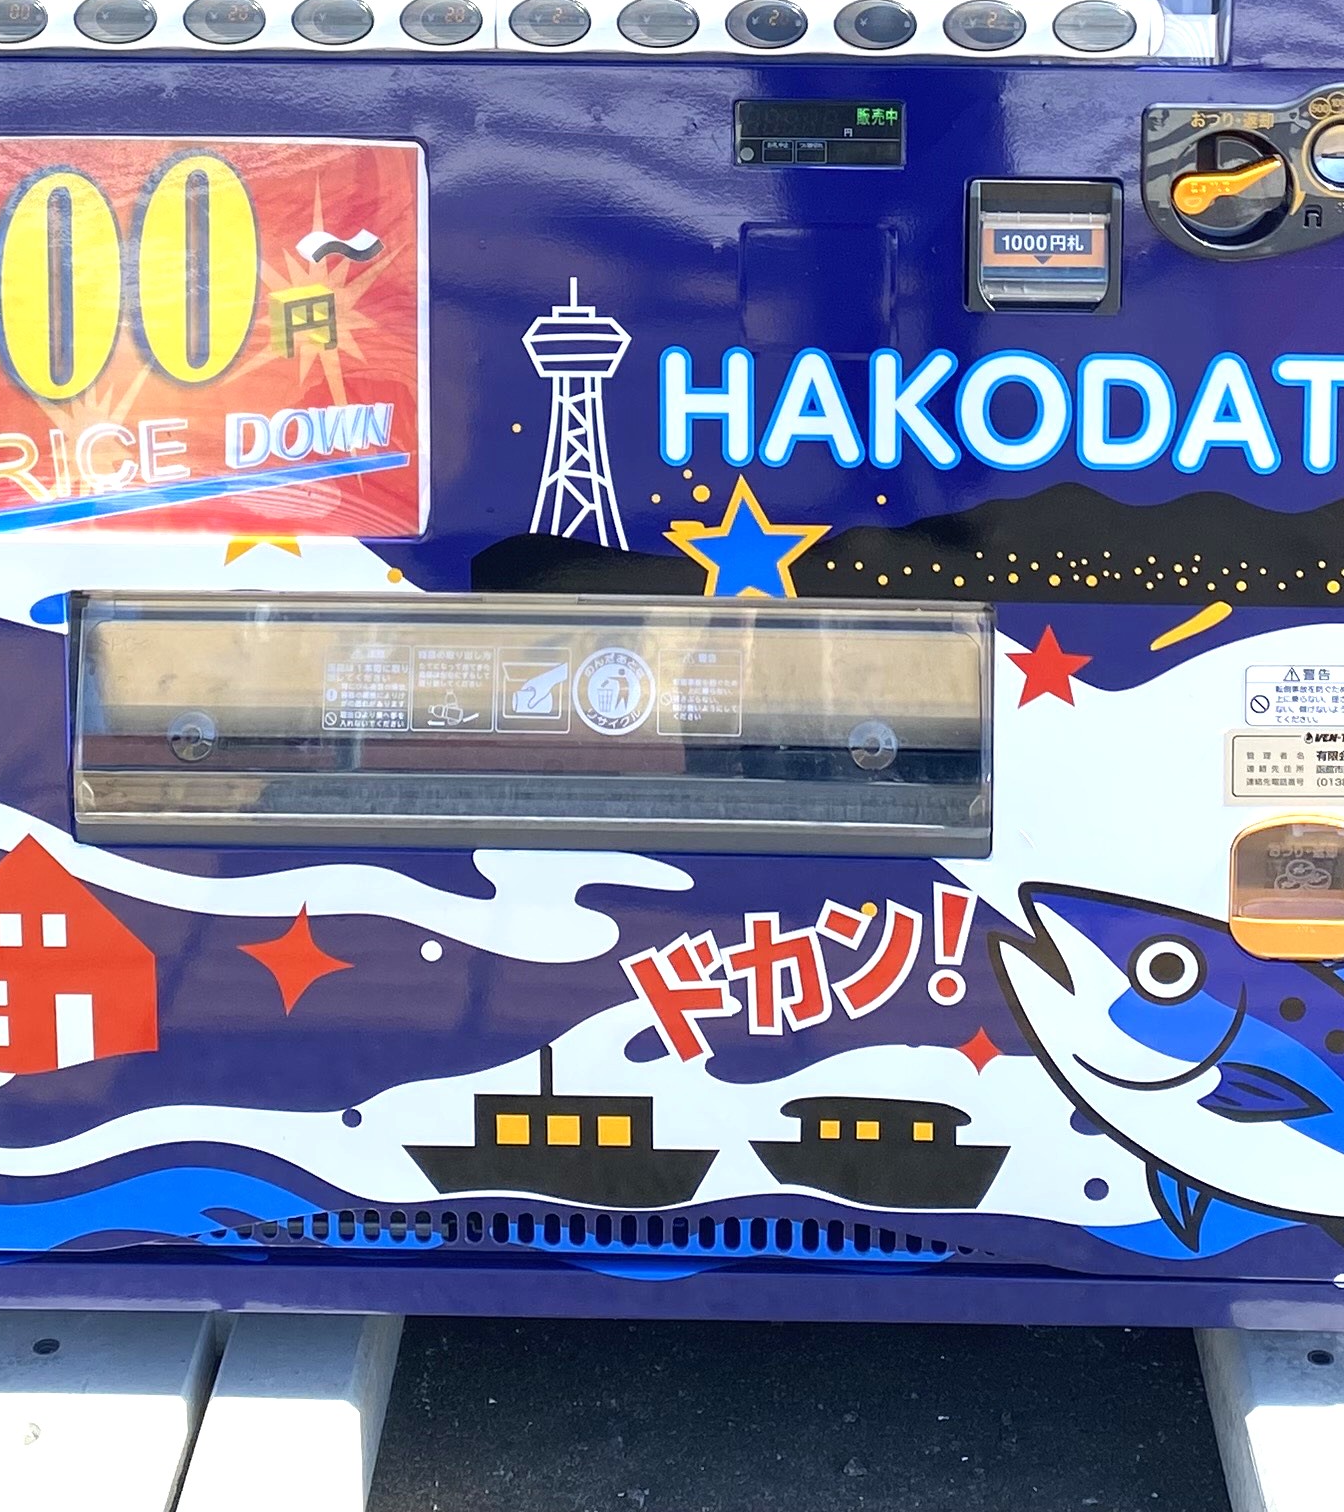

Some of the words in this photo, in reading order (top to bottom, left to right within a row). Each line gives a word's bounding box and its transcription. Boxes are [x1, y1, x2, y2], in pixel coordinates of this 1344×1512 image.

[856, 107, 899, 126] 販売中
[843, 127, 853, 137] 円
[1001, 234, 1084, 252] 1000円札
[225, 403, 396, 471] DOWN
[1303, 668, 1331, 681] 警告
[586, 707, 641, 729] リサイクル
[619, 881, 980, 1064] ドカン!
